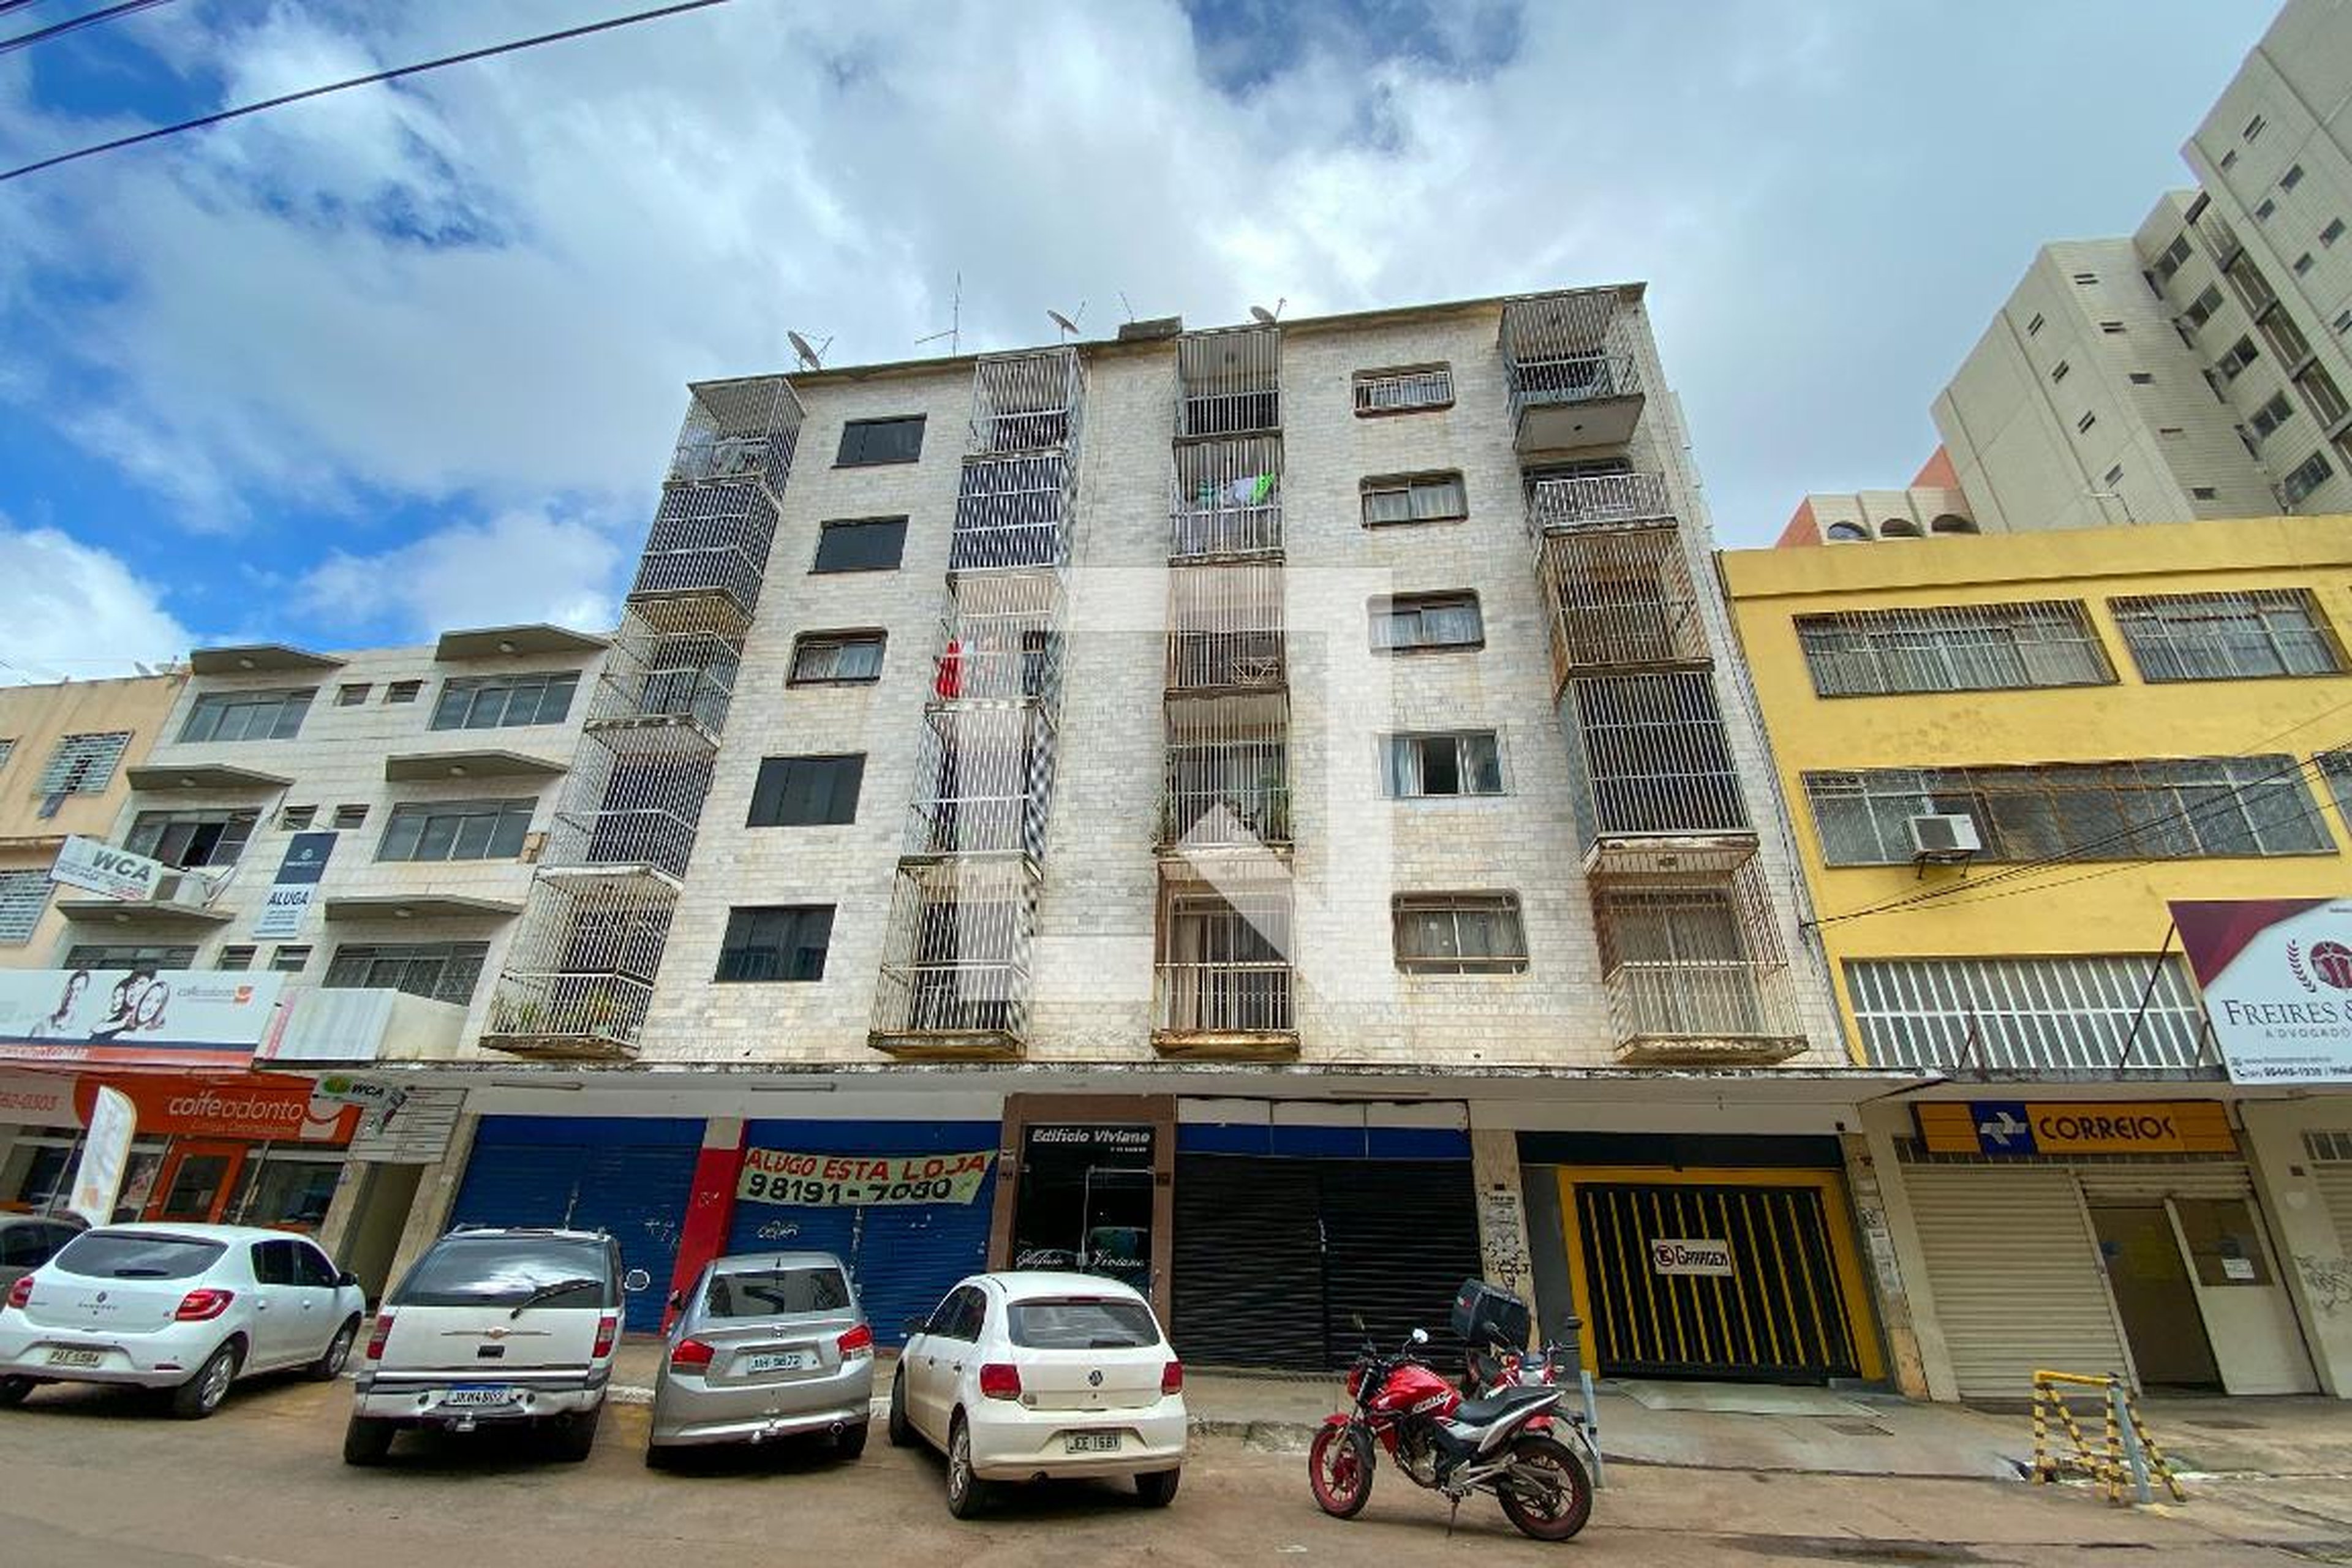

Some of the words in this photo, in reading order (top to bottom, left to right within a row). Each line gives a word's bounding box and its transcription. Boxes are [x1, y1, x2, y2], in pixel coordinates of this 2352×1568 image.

[92, 850, 152, 883] WCA
[267, 891, 309, 906] ALUGA
[2222, 1000, 2338, 1025] FREIRES
[2266, 1028, 2351, 1038] ADVOGADO
[351, 1084, 385, 1097] WCA
[168, 1089, 303, 1120] coifeodonto
[2040, 1116, 2176, 1140] CORREIOS
[746, 1148, 815, 1177] ALUGO
[822, 1158, 889, 1181] ESTA
[902, 1155, 986, 1182] LOJA
